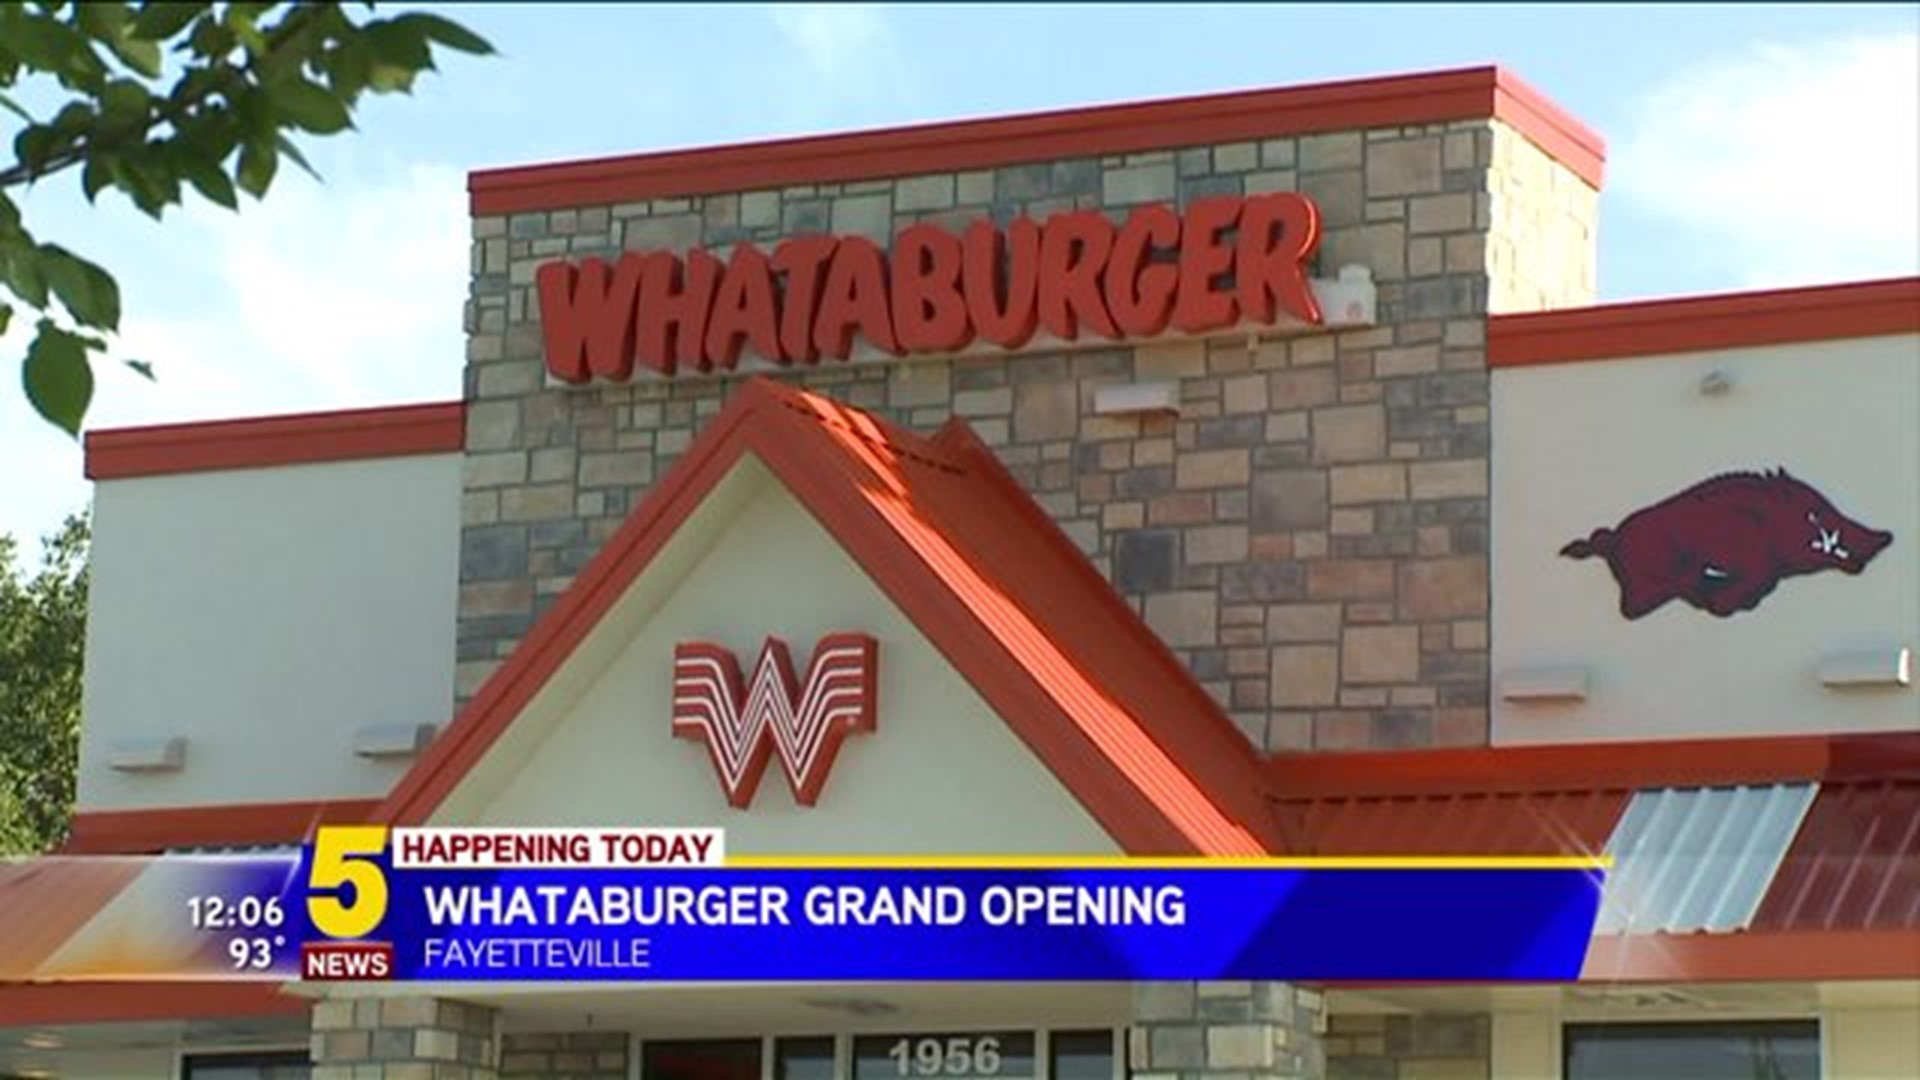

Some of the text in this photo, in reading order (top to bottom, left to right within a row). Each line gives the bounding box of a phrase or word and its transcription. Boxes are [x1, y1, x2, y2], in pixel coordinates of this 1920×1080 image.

[537, 191, 1321, 383] WHATABURGER
[672, 632, 878, 810] W
[889, 1036, 1001, 1076] 1956
